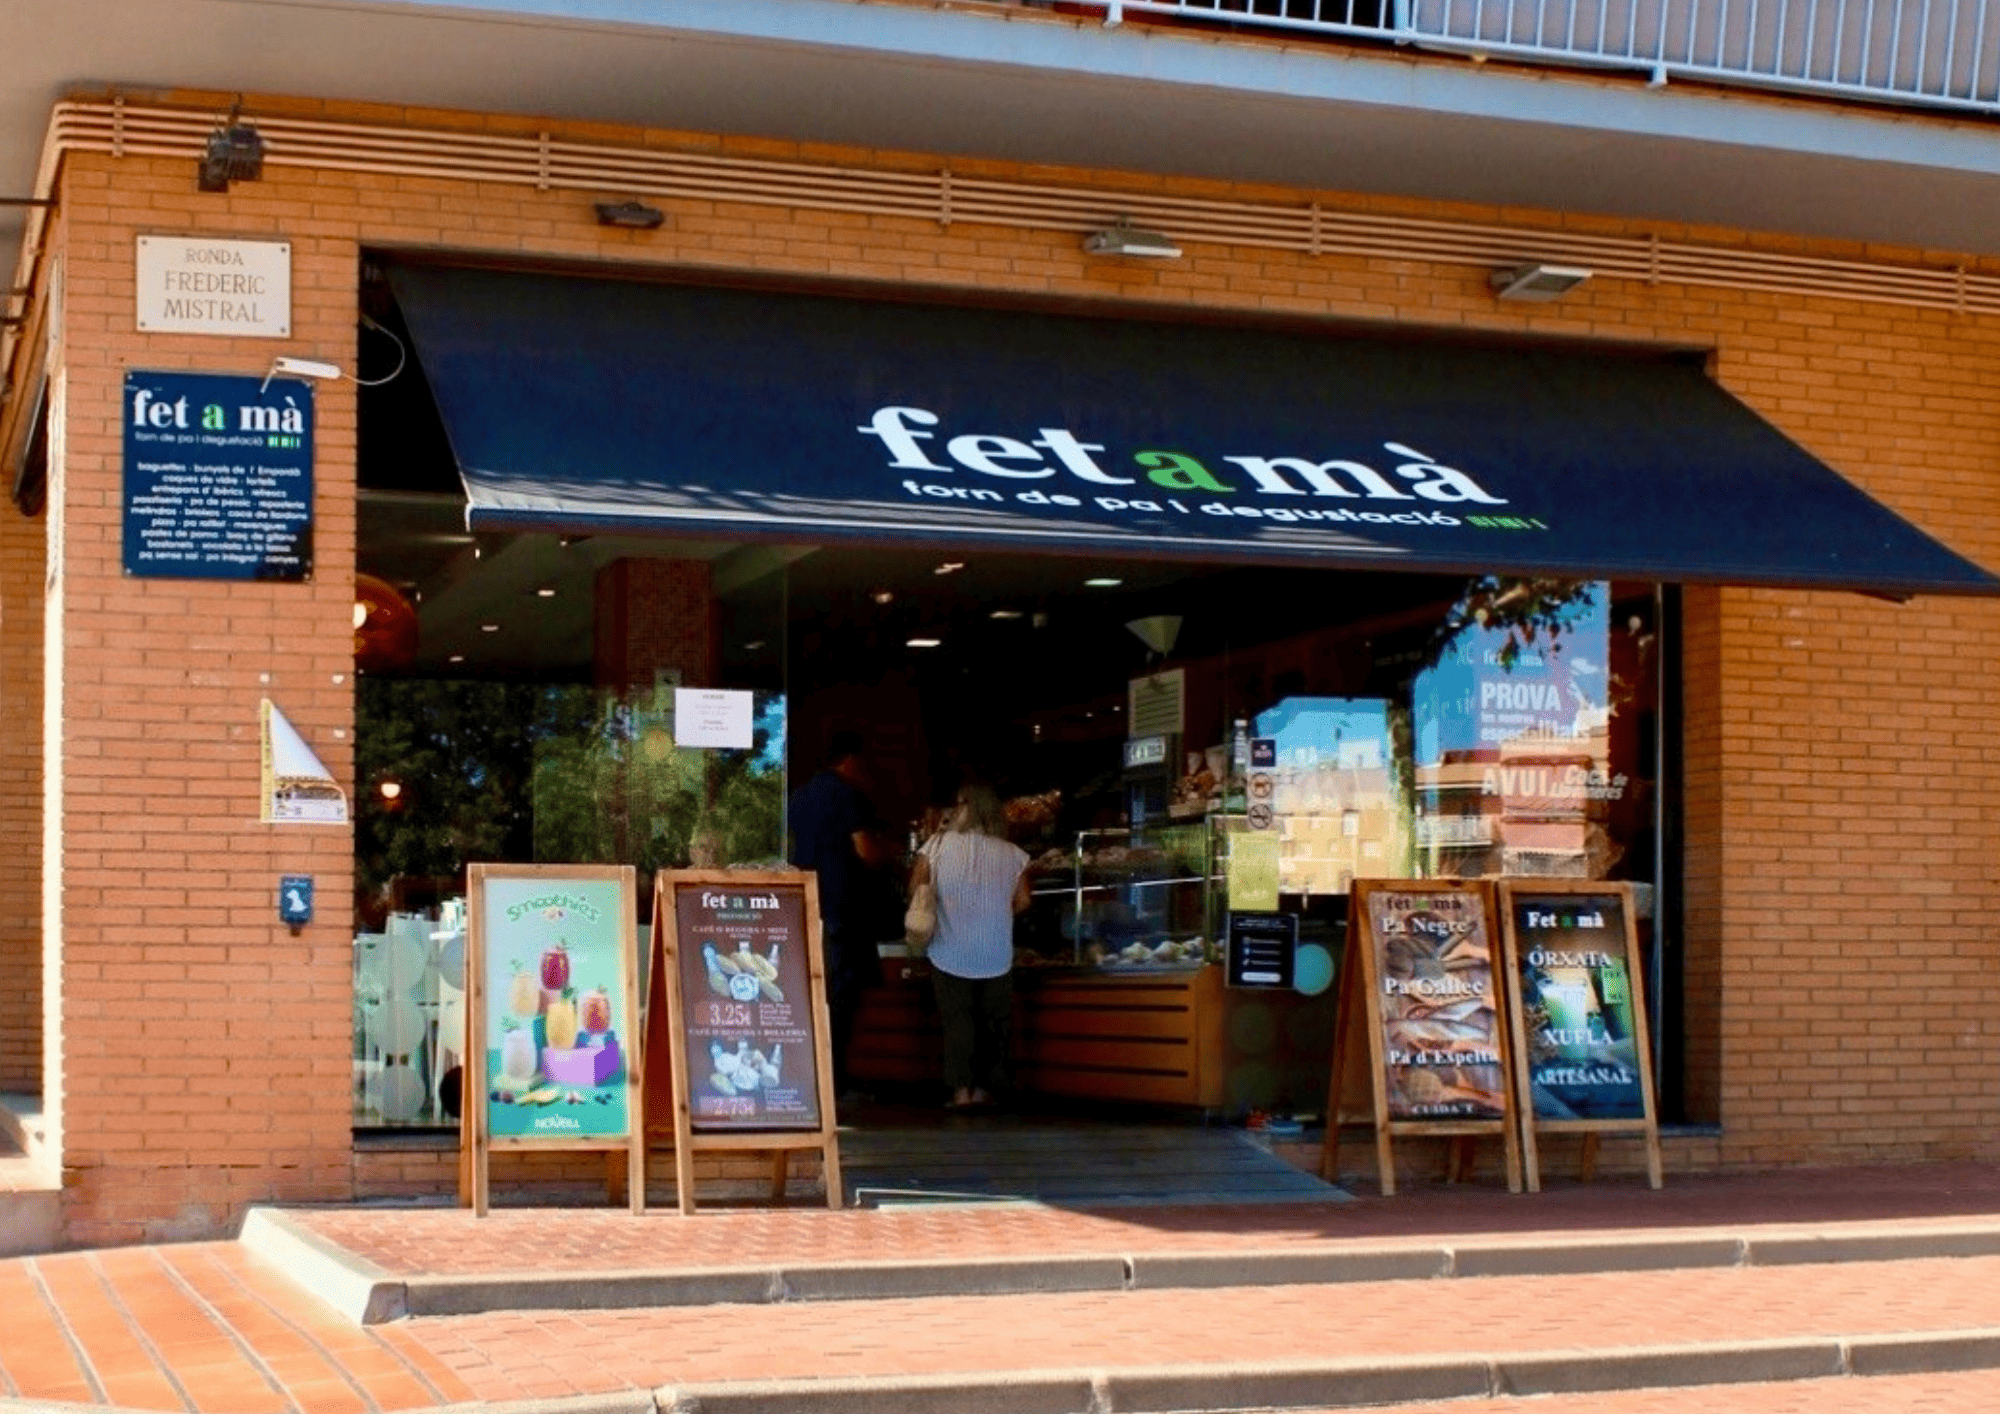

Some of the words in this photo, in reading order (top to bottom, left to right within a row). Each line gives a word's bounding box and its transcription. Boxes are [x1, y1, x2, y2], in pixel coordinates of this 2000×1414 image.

[186, 248, 244, 265] RONDA
[164, 270, 266, 294] FREDERIC
[163, 298, 265, 323] MISTRAL
[133, 389, 189, 428] fet
[202, 403, 226, 431] a
[239, 396, 304, 434] mà
[134, 431, 158, 442] forn
[160, 433, 176, 442] de
[178, 435, 194, 444] pa
[201, 434, 264, 447] degustació
[856, 405, 1136, 485] fet
[1133, 450, 1236, 491] a
[1222, 441, 1509, 505] mà
[200, 475, 213, 484] de
[232, 465, 245, 475] de
[206, 497, 219, 506] de
[902, 480, 1004, 502] forn
[1016, 490, 1082, 507] de
[1094, 496, 1164, 513] pa
[1167, 498, 1190, 515] i
[1200, 502, 1461, 526] degustació
[175, 529, 188, 538] de
[250, 532, 264, 541] de
[1481, 681, 1562, 711] PROVA
[1481, 765, 1548, 798] AVUI
[702, 891, 728, 909] fet
[750, 892, 780, 909] mà
[1382, 917, 1406, 933] Pa
[1412, 917, 1467, 937] Negre
[1527, 911, 1558, 928] Fet
[1577, 911, 1605, 928] mà
[1385, 977, 1410, 995] Pa
[1417, 977, 1484, 996] Gallec
[1543, 1027, 1615, 1046] XUFLA
[1535, 1067, 1633, 1086] ARTESANAL
